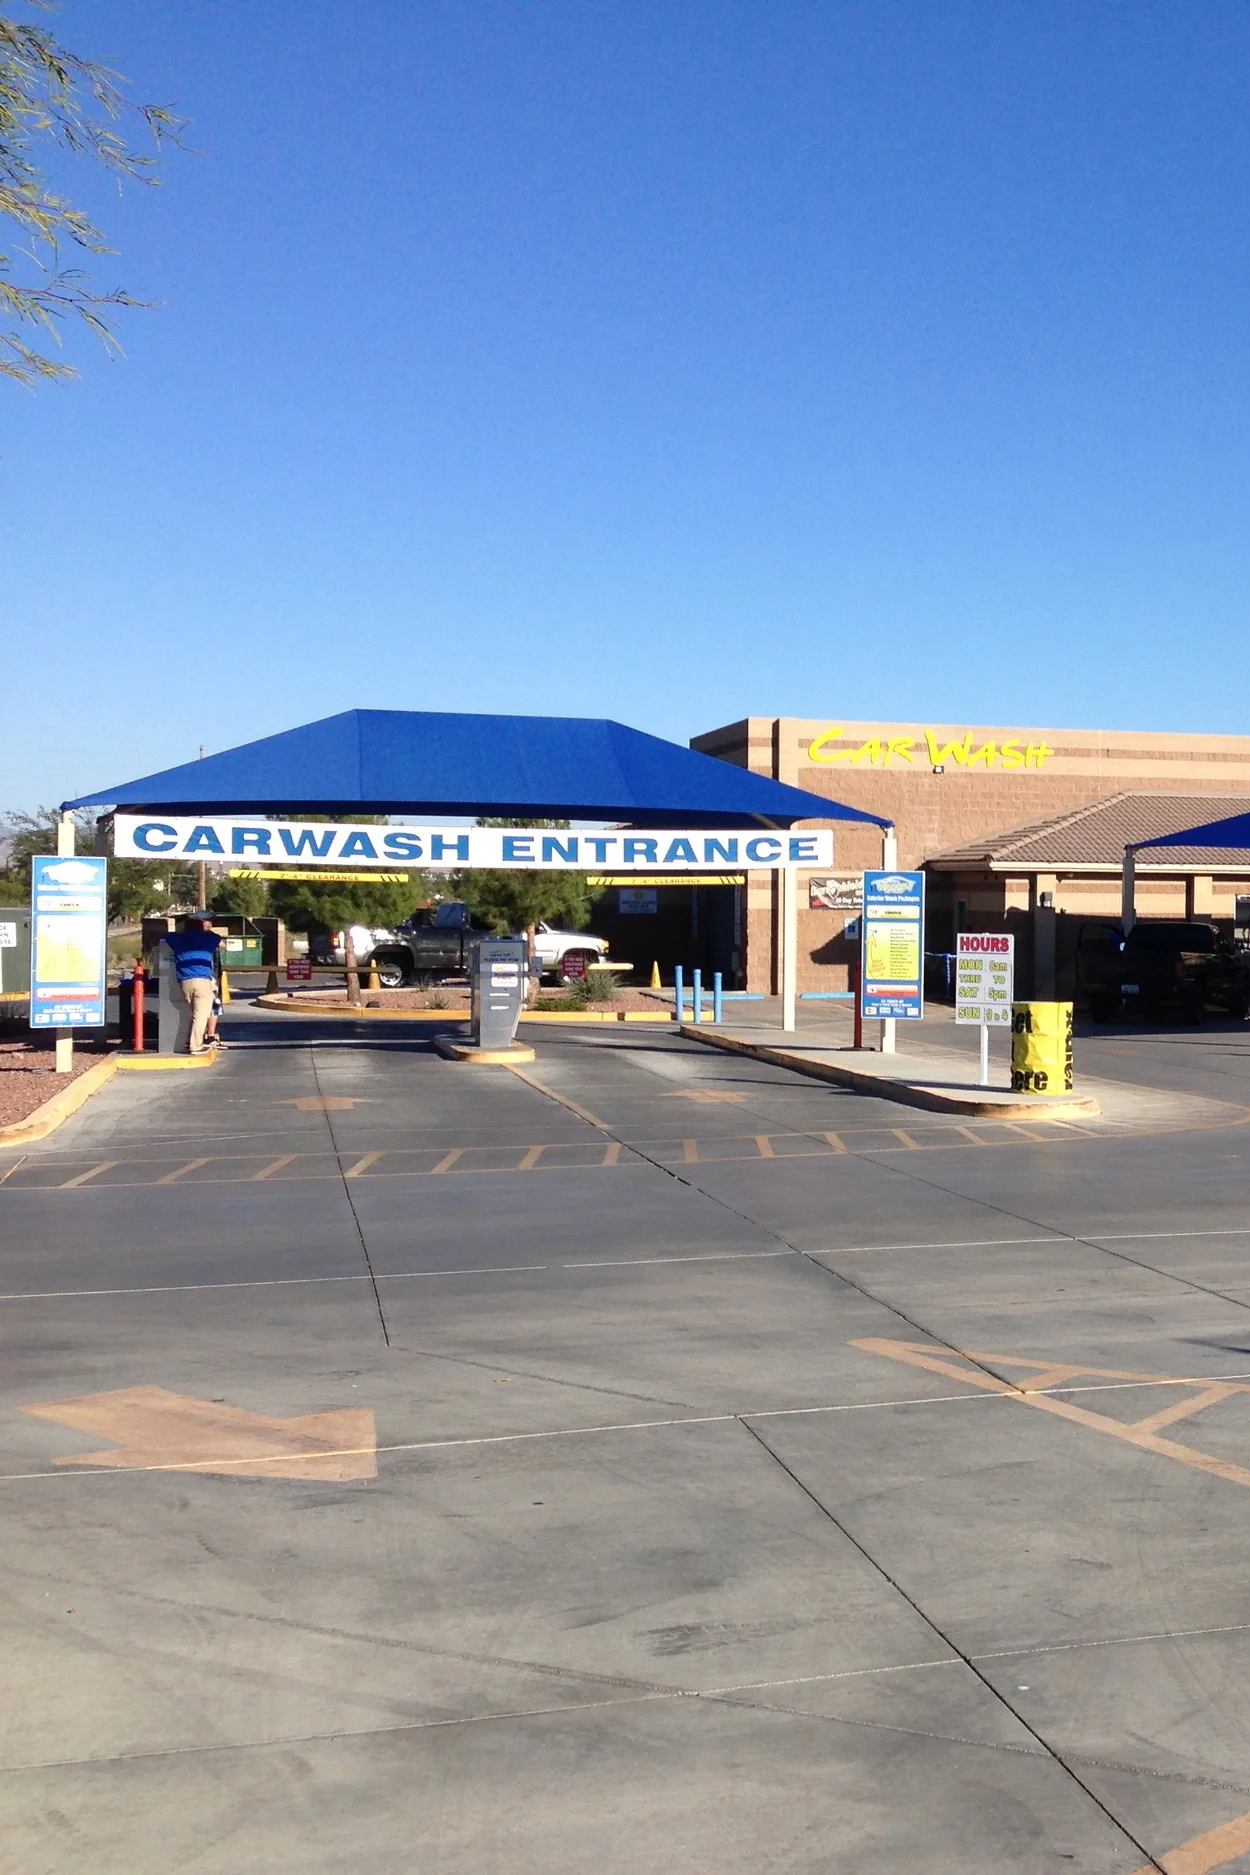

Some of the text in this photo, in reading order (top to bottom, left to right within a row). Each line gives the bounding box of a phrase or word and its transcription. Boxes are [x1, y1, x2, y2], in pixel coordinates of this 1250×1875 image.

[132, 822, 819, 863] CARWASH ENTRANCE
[960, 936, 1010, 953] HOURS
[959, 959, 983, 971] MON
[959, 974, 982, 983] THRU
[959, 986, 980, 998] SAT
[958, 1006, 981, 1020] SUN
[986, 1008, 993, 1020] 9
